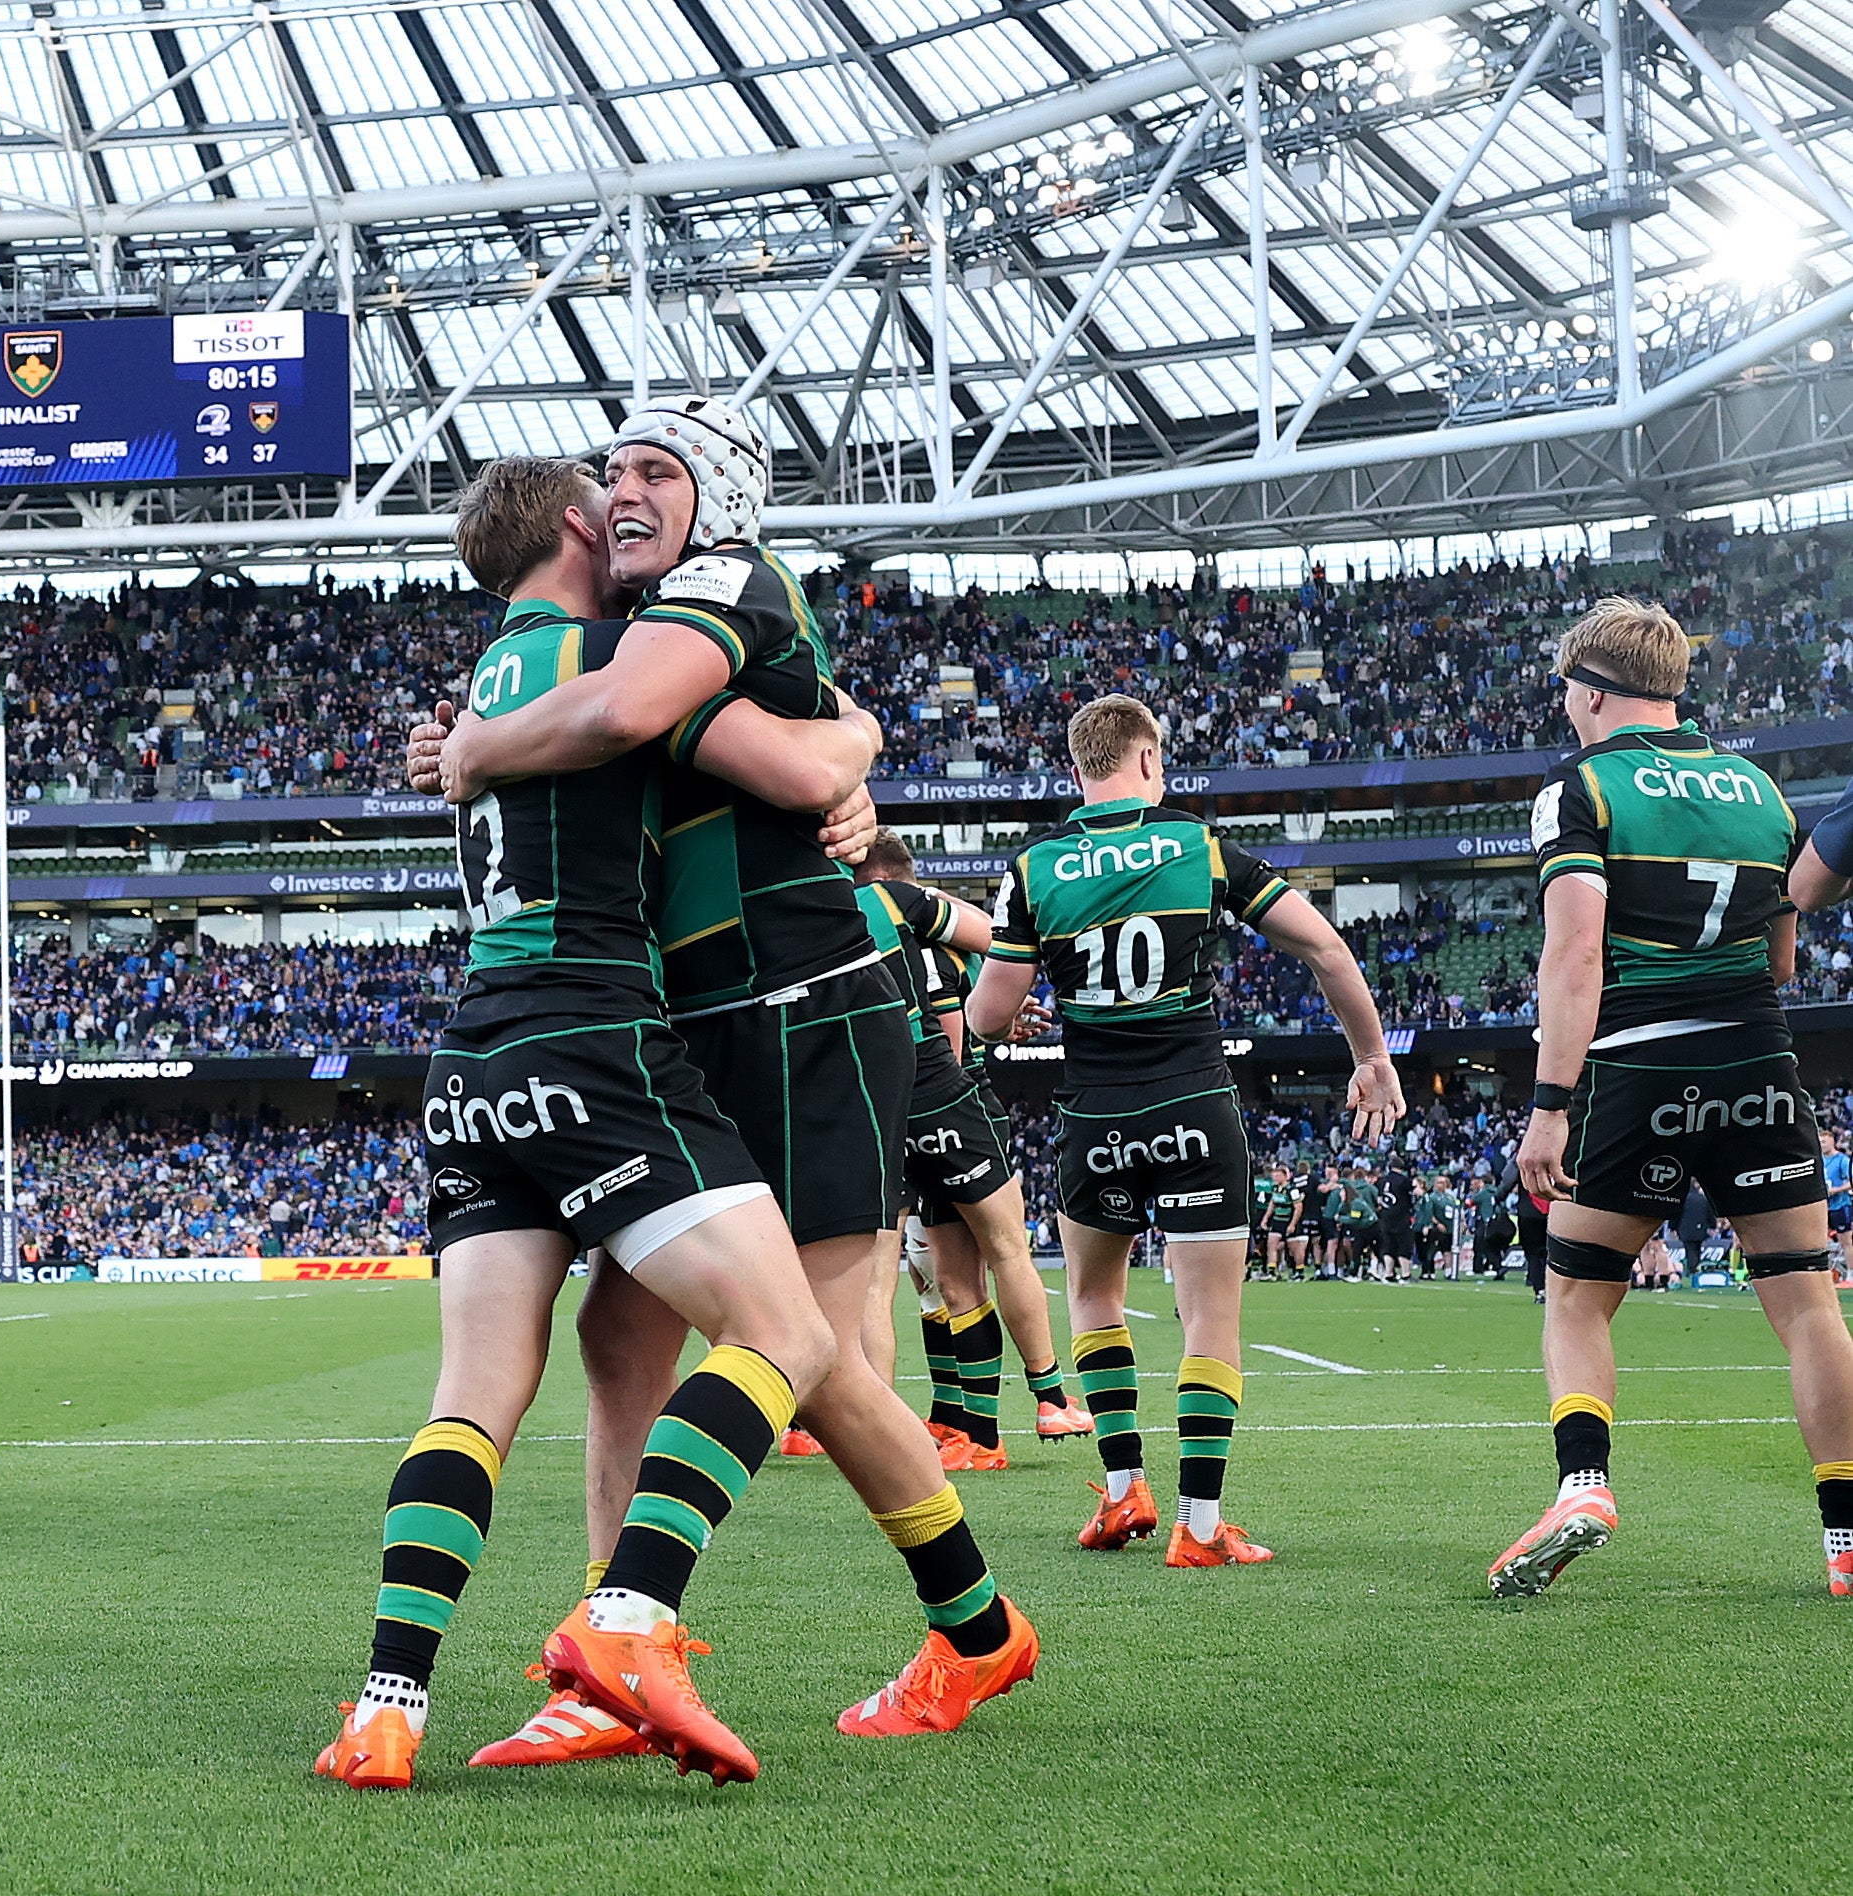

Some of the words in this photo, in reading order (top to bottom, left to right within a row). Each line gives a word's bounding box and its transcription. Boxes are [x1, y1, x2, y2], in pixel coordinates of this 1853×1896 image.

[194, 336, 285, 353] TISSOT
[208, 365, 277, 390] 80:15
[33, 455, 56, 466] CUP
[203, 445, 229, 464] 34
[253, 443, 277, 463] 37
[679, 574, 733, 591] Investec
[1171, 776, 1210, 793] CUP
[1633, 756, 1763, 805] cinch
[922, 781, 1012, 800] Investec
[381, 800, 425, 813] YEARS
[426, 800, 444, 812] OF
[1475, 836, 1531, 854] Inves
[926, 861, 971, 873] YEARS
[972, 860, 992, 872] OF
[1054, 834, 1183, 882] cinch
[288, 874, 375, 892] Investec
[1687, 861, 1738, 949] 7
[1075, 915, 1165, 1006] 10
[1010, 1044, 1065, 1061] Invest
[66, 1062, 159, 1080] CHAMPIONS
[159, 1061, 194, 1078] CUP
[424, 1074, 590, 1146] cinch
[1650, 1085, 1795, 1137] cinch
[905, 1128, 963, 1155] nch
[1087, 1124, 1210, 1174] cinch
[1649, 1163, 1677, 1184] TP
[1734, 1166, 1783, 1187] GT
[1782, 1164, 1815, 1176] RADIAL
[559, 1180, 605, 1219] GT
[602, 1161, 649, 1189] RADIAL
[466, 1199, 496, 1213] Perkins
[1104, 1194, 1128, 1208] TP
[1158, 1193, 1190, 1208] GT
[37, 1265, 77, 1284] CUP
[131, 1265, 243, 1283] Investec
[295, 1262, 394, 1280] DHL
